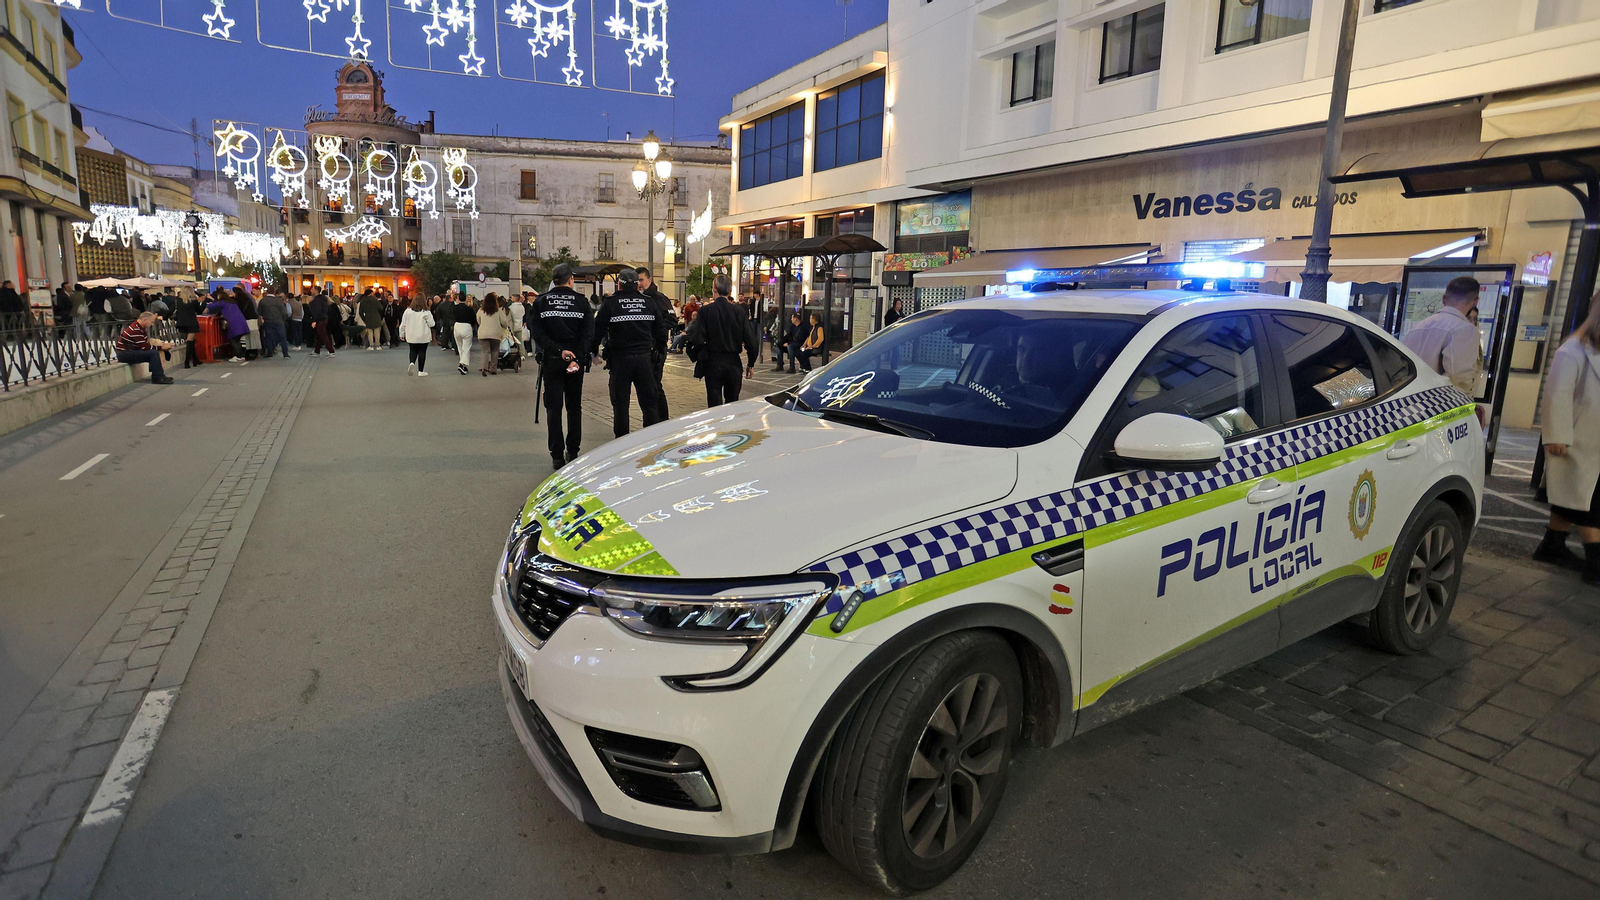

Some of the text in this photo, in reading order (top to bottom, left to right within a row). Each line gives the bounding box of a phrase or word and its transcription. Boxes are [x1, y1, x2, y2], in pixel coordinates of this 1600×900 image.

[1132, 187, 1358, 220] Vanessa CALDOS
[921, 212, 957, 227] Lola
[912, 259, 939, 268] Lola
[1454, 422, 1469, 440] 092
[1156, 484, 1326, 598] POLICÍA
[1248, 541, 1322, 594] LOCAL
[1372, 551, 1388, 571] 112
